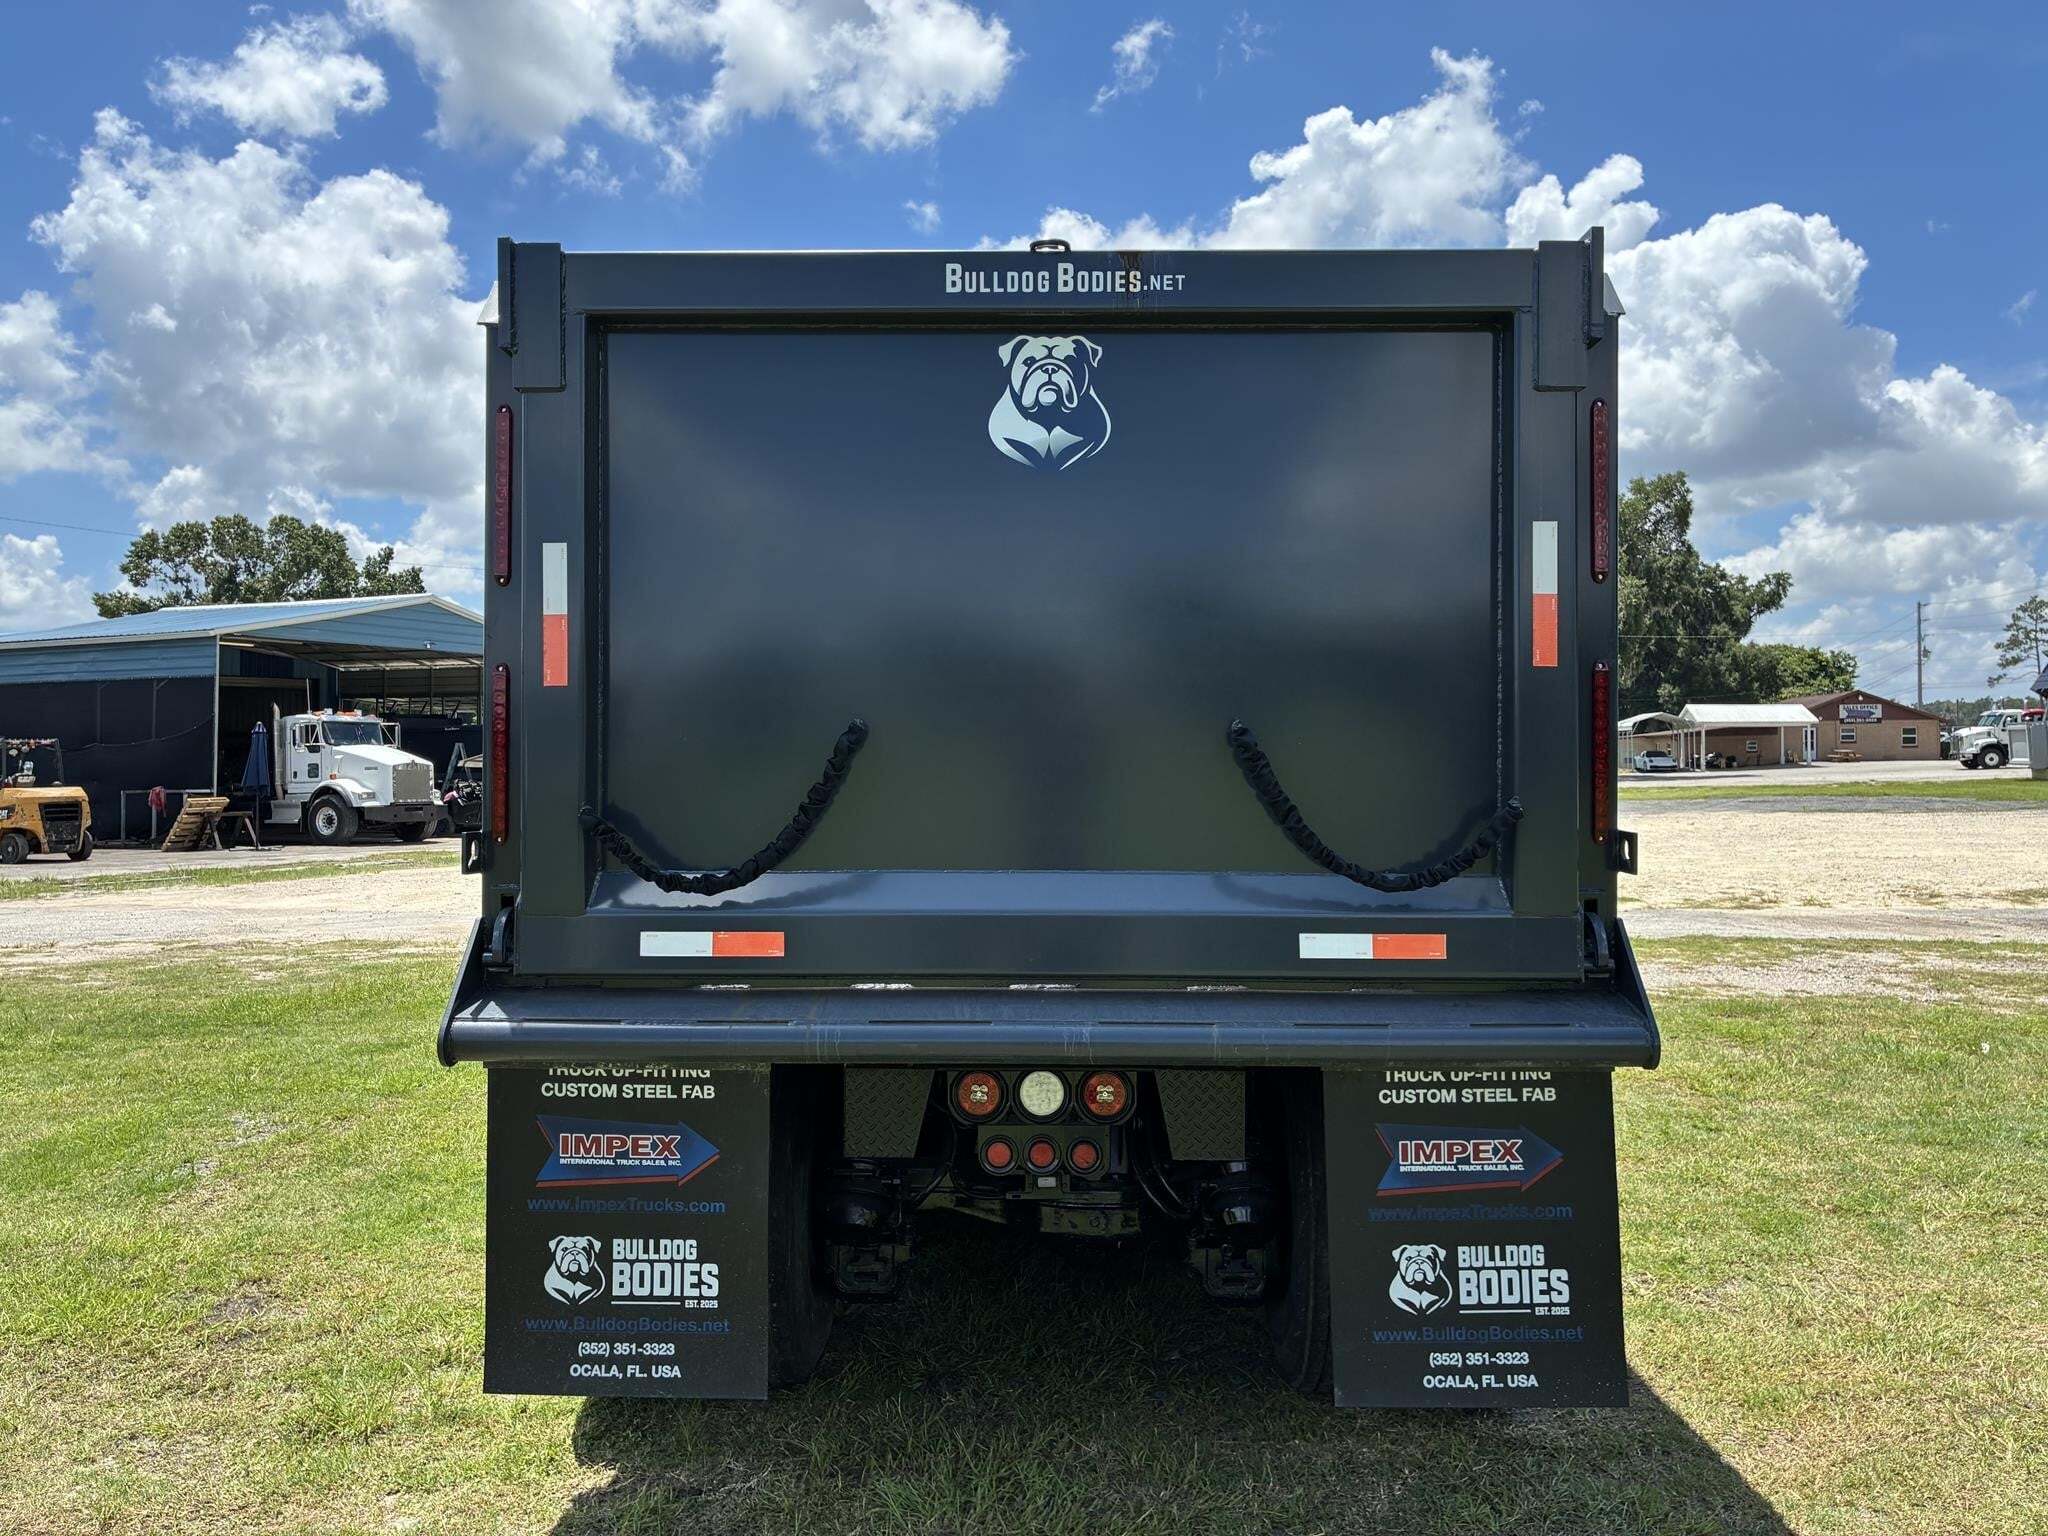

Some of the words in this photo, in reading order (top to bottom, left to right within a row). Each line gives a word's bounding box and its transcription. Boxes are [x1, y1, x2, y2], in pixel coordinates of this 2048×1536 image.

[945, 263, 1050, 293] BULLDOG
[1057, 262, 1186, 293] BODIES.NET
[549, 1068, 607, 1077] TRUCK
[1385, 1071, 1446, 1082] TRUCK
[541, 1083, 617, 1098] CUSTOM
[622, 1084, 677, 1099] STEEL
[682, 1085, 715, 1099] FAB
[1378, 1089, 1457, 1104] CUSTOM
[1461, 1088, 1518, 1103] STEEL
[1522, 1087, 1557, 1102] FAB
[559, 1133, 681, 1159] IMPEX
[1399, 1139, 1523, 1165] IMPEX
[559, 1158, 615, 1166] INTERNATIONAL
[641, 1159, 667, 1167] SALES,
[1483, 1164, 1509, 1172] SALES,
[527, 1198, 726, 1213] www.ImpexTrucks.com
[1368, 1204, 1574, 1221] www.ImpexTrucks.com
[612, 1238, 697, 1260] BULLDOG
[1457, 1245, 1545, 1267] BULLDOG
[612, 1262, 719, 1297] BODIES
[1458, 1269, 1570, 1305] BODIES
[685, 1300, 699, 1308] EST.
[700, 1300, 719, 1309] 2025
[1535, 1307, 1550, 1316] EST.
[1551, 1306, 1570, 1315] 2025
[525, 1316, 730, 1333] www.BulldogBodies.net
[1373, 1325, 1584, 1343] www.BulldogBodies.net
[578, 1341, 610, 1357] (352)
[613, 1342, 675, 1356] 351-3323
[1429, 1352, 1462, 1368] (352)
[1466, 1351, 1529, 1366] 351-3323
[569, 1364, 623, 1379] OCALA,
[626, 1365, 648, 1378] FL.
[651, 1365, 682, 1378] USA
[1423, 1374, 1479, 1390] OCALA,
[1482, 1374, 1503, 1388] FL.
[1507, 1374, 1538, 1388] USA
